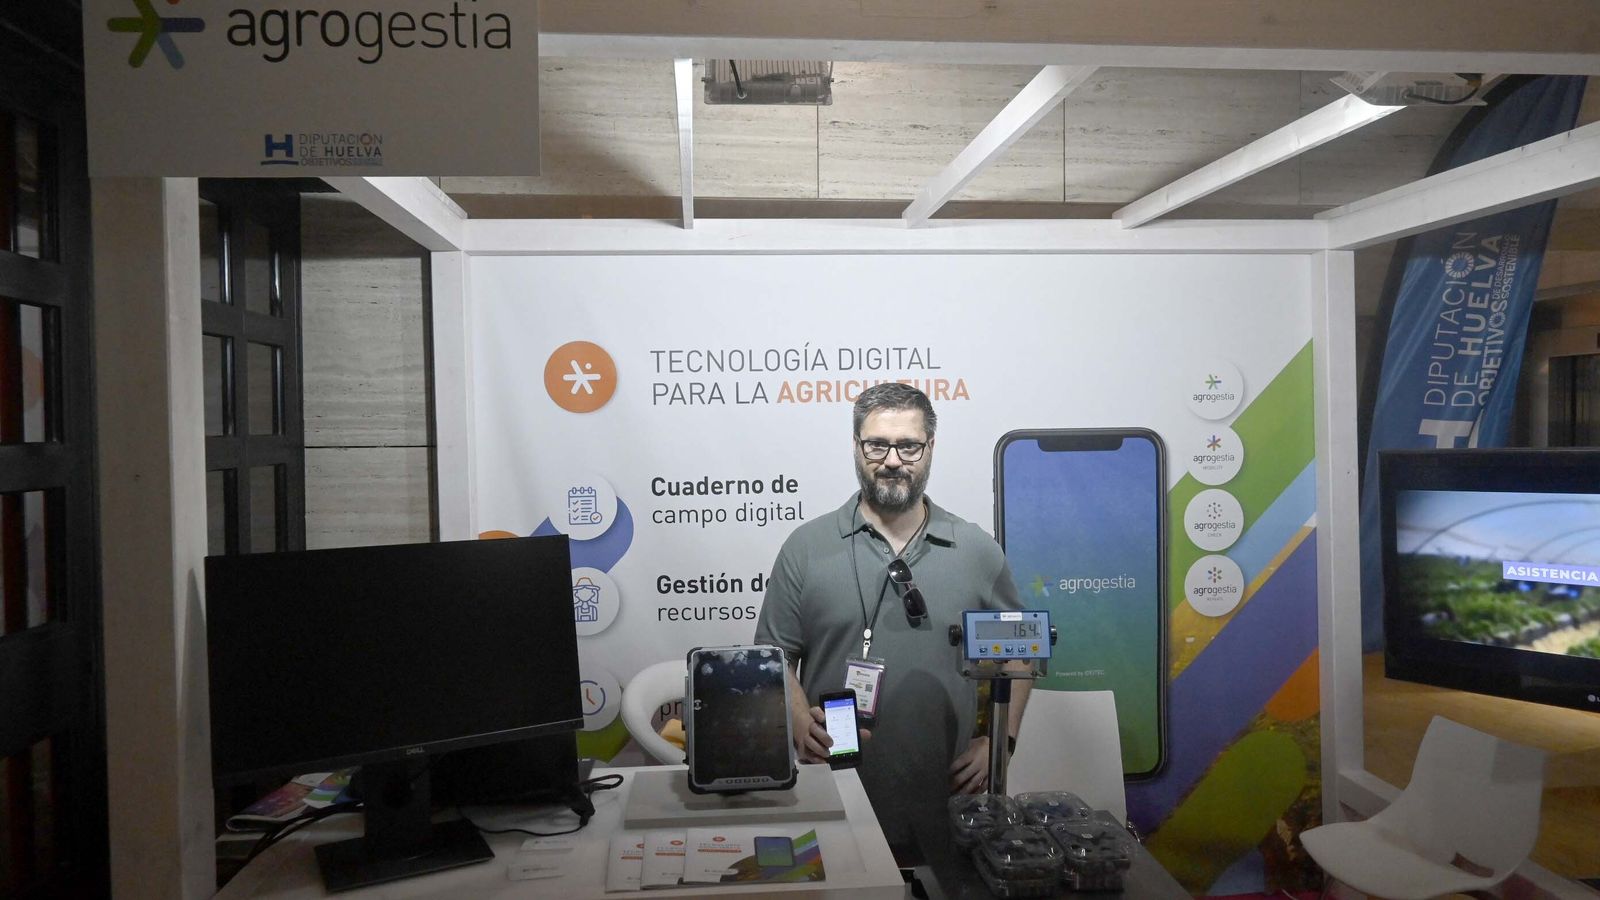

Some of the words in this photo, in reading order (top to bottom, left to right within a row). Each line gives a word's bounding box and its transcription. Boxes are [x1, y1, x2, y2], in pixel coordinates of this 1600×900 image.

[227, 0, 511, 63] agrogestia
[300, 147, 319, 157] DE
[325, 146, 382, 157] HUELVA
[1458, 235, 1501, 356] HUELVA
[1424, 233, 1477, 405] DIPUTACIÓN
[650, 342, 828, 373] TECNOLOGÍA
[838, 347, 941, 371] DIGITAL
[653, 382, 726, 405] PARA
[736, 381, 769, 404] LA
[777, 378, 971, 403] AGRICURA
[1193, 393, 1235, 403] agrogestia
[1451, 372, 1478, 406] DE
[1193, 453, 1235, 464] agrogestia
[651, 476, 764, 496] Cuaderno
[771, 474, 799, 494] de
[652, 508, 727, 528] campo
[735, 501, 804, 527] digital
[1194, 520, 1236, 531] agrogestia
[656, 572, 743, 594] Gestión
[751, 573, 770, 592] d
[1060, 573, 1136, 594] agrogestia
[1506, 565, 1599, 582] ASISTENCIA
[1193, 585, 1237, 597] agrogestia
[658, 605, 756, 621] recursos
